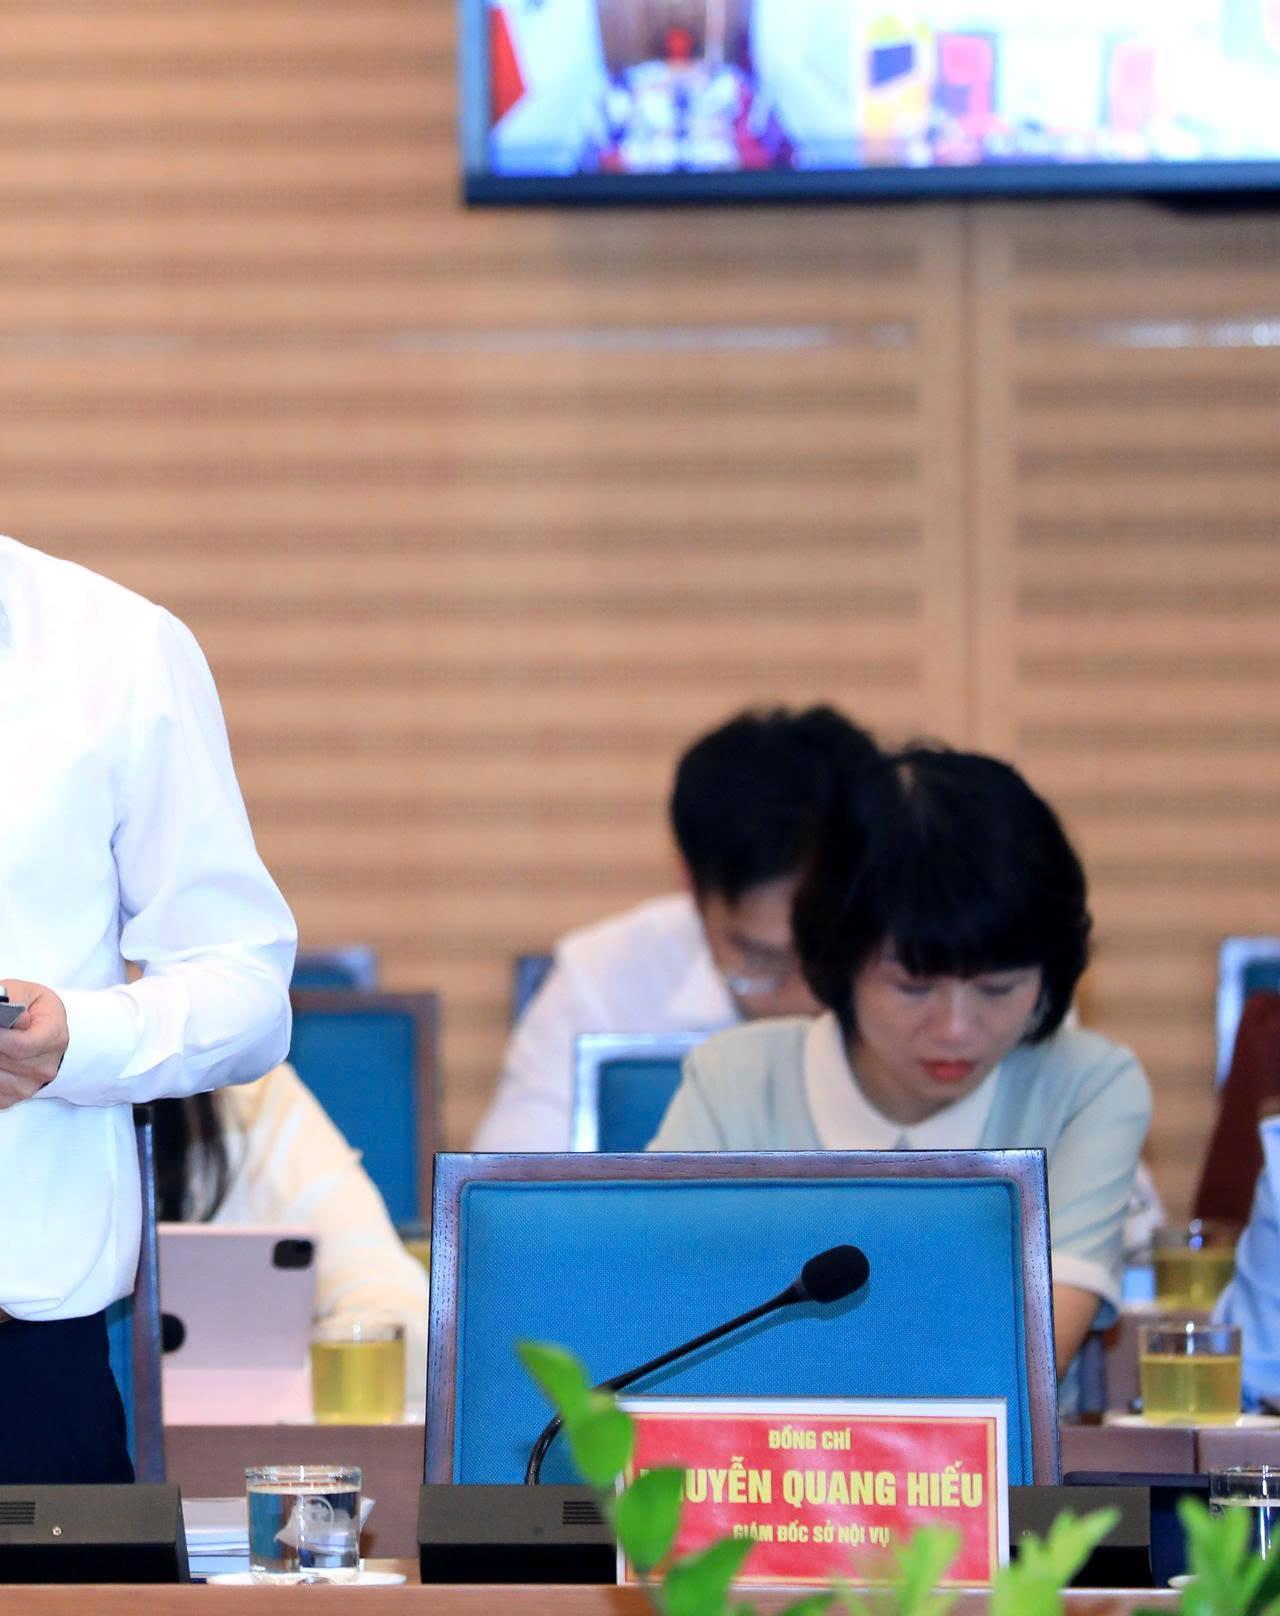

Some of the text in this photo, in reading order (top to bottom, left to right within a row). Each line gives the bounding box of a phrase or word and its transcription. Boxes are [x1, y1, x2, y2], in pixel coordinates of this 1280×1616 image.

[822, 1427, 851, 1450] CHÍ
[640, 1456, 983, 1508] UYỄN QUANG HIẾU
[813, 1519, 834, 1543] SỞ
[838, 1523, 865, 1547] NỘI
[869, 1526, 890, 1548] VỤ
